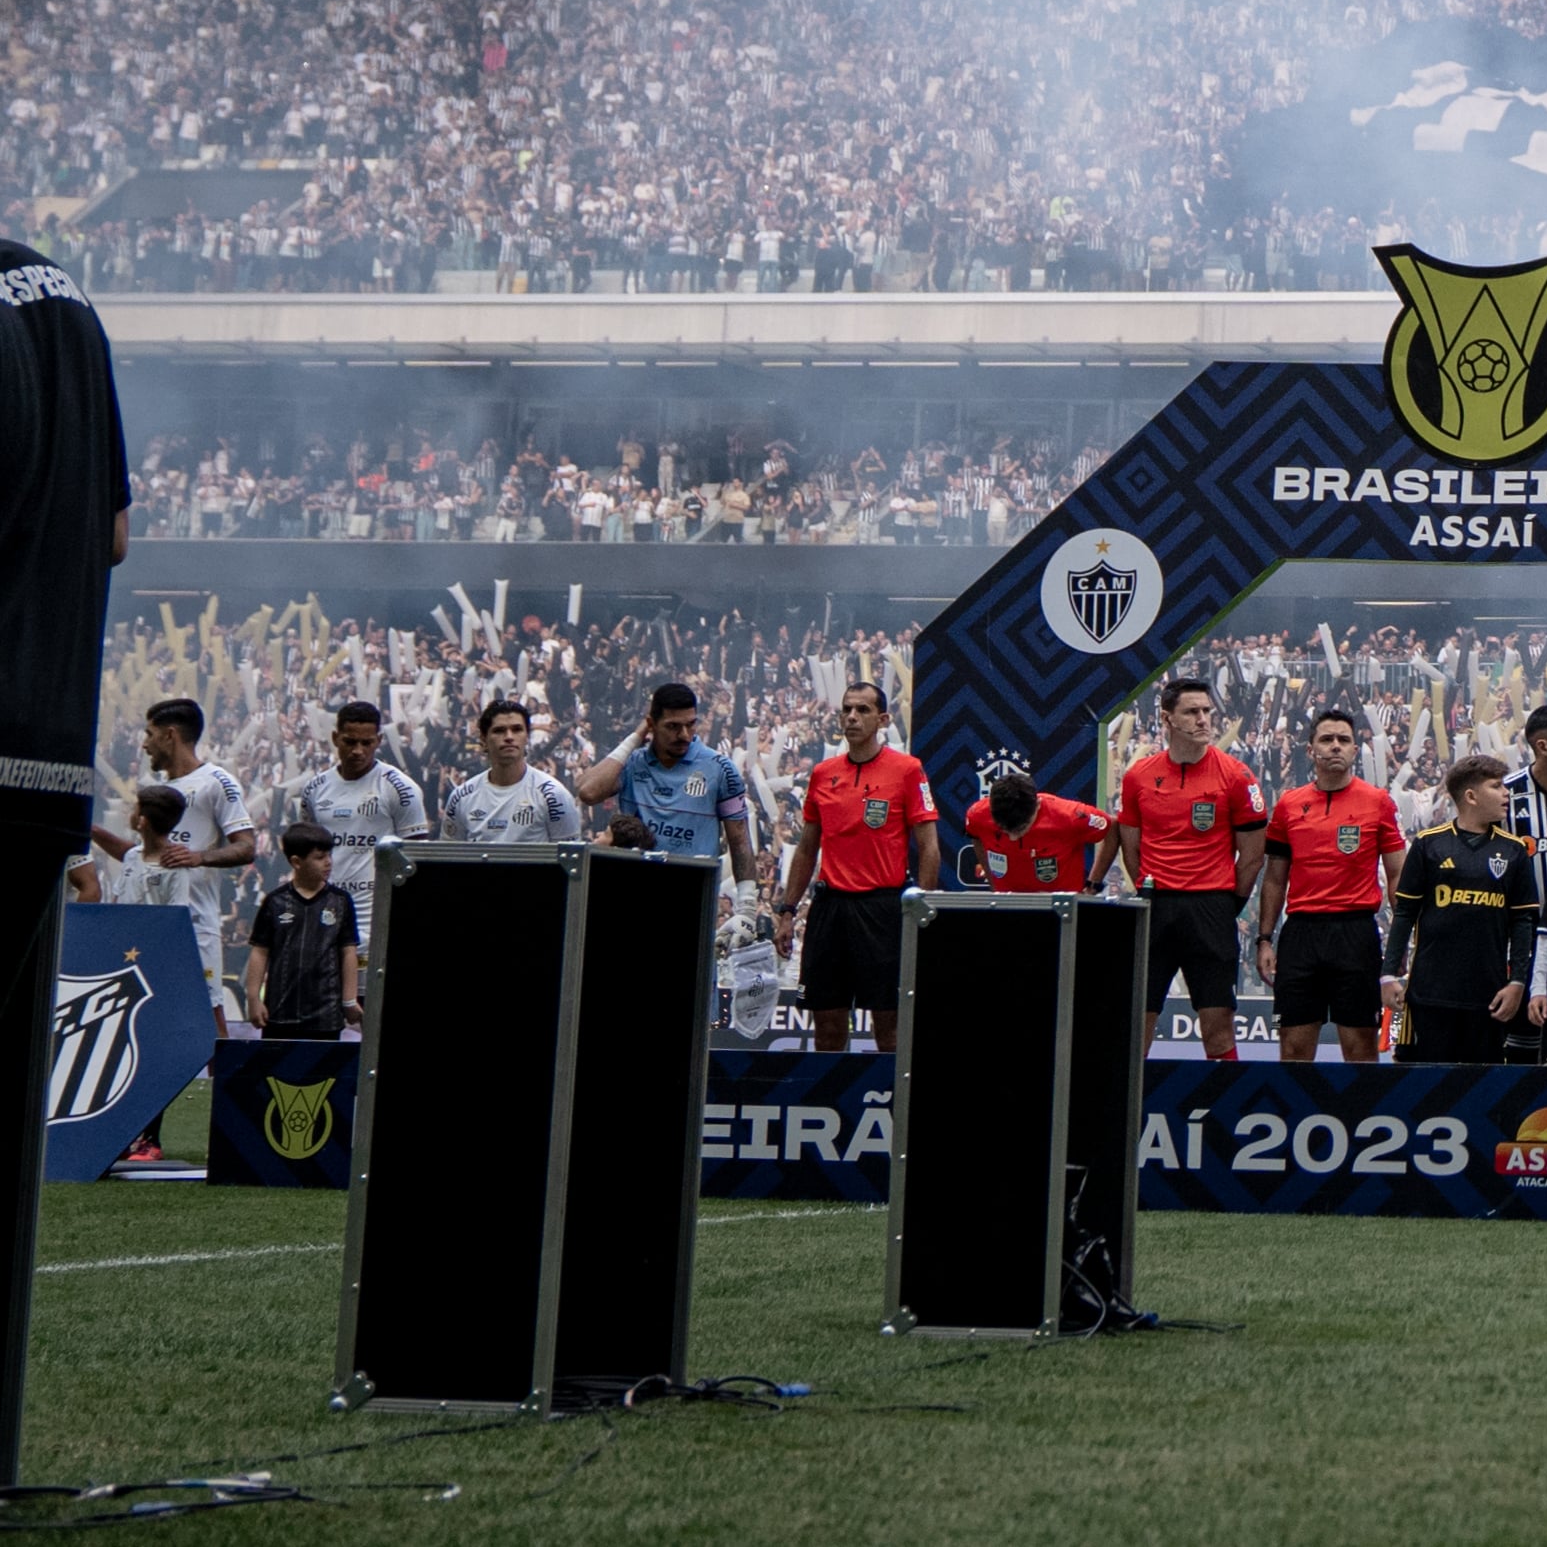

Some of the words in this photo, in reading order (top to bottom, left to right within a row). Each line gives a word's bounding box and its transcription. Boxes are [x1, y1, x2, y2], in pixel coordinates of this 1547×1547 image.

[1410, 513, 1537, 547] ASSAÍ
[1077, 577, 1127, 590] CAM
[648, 820, 694, 840] blaze
[332, 833, 377, 847] blaze
[1451, 890, 1506, 909] BETANO
[1231, 1112, 1470, 1176] 2023
